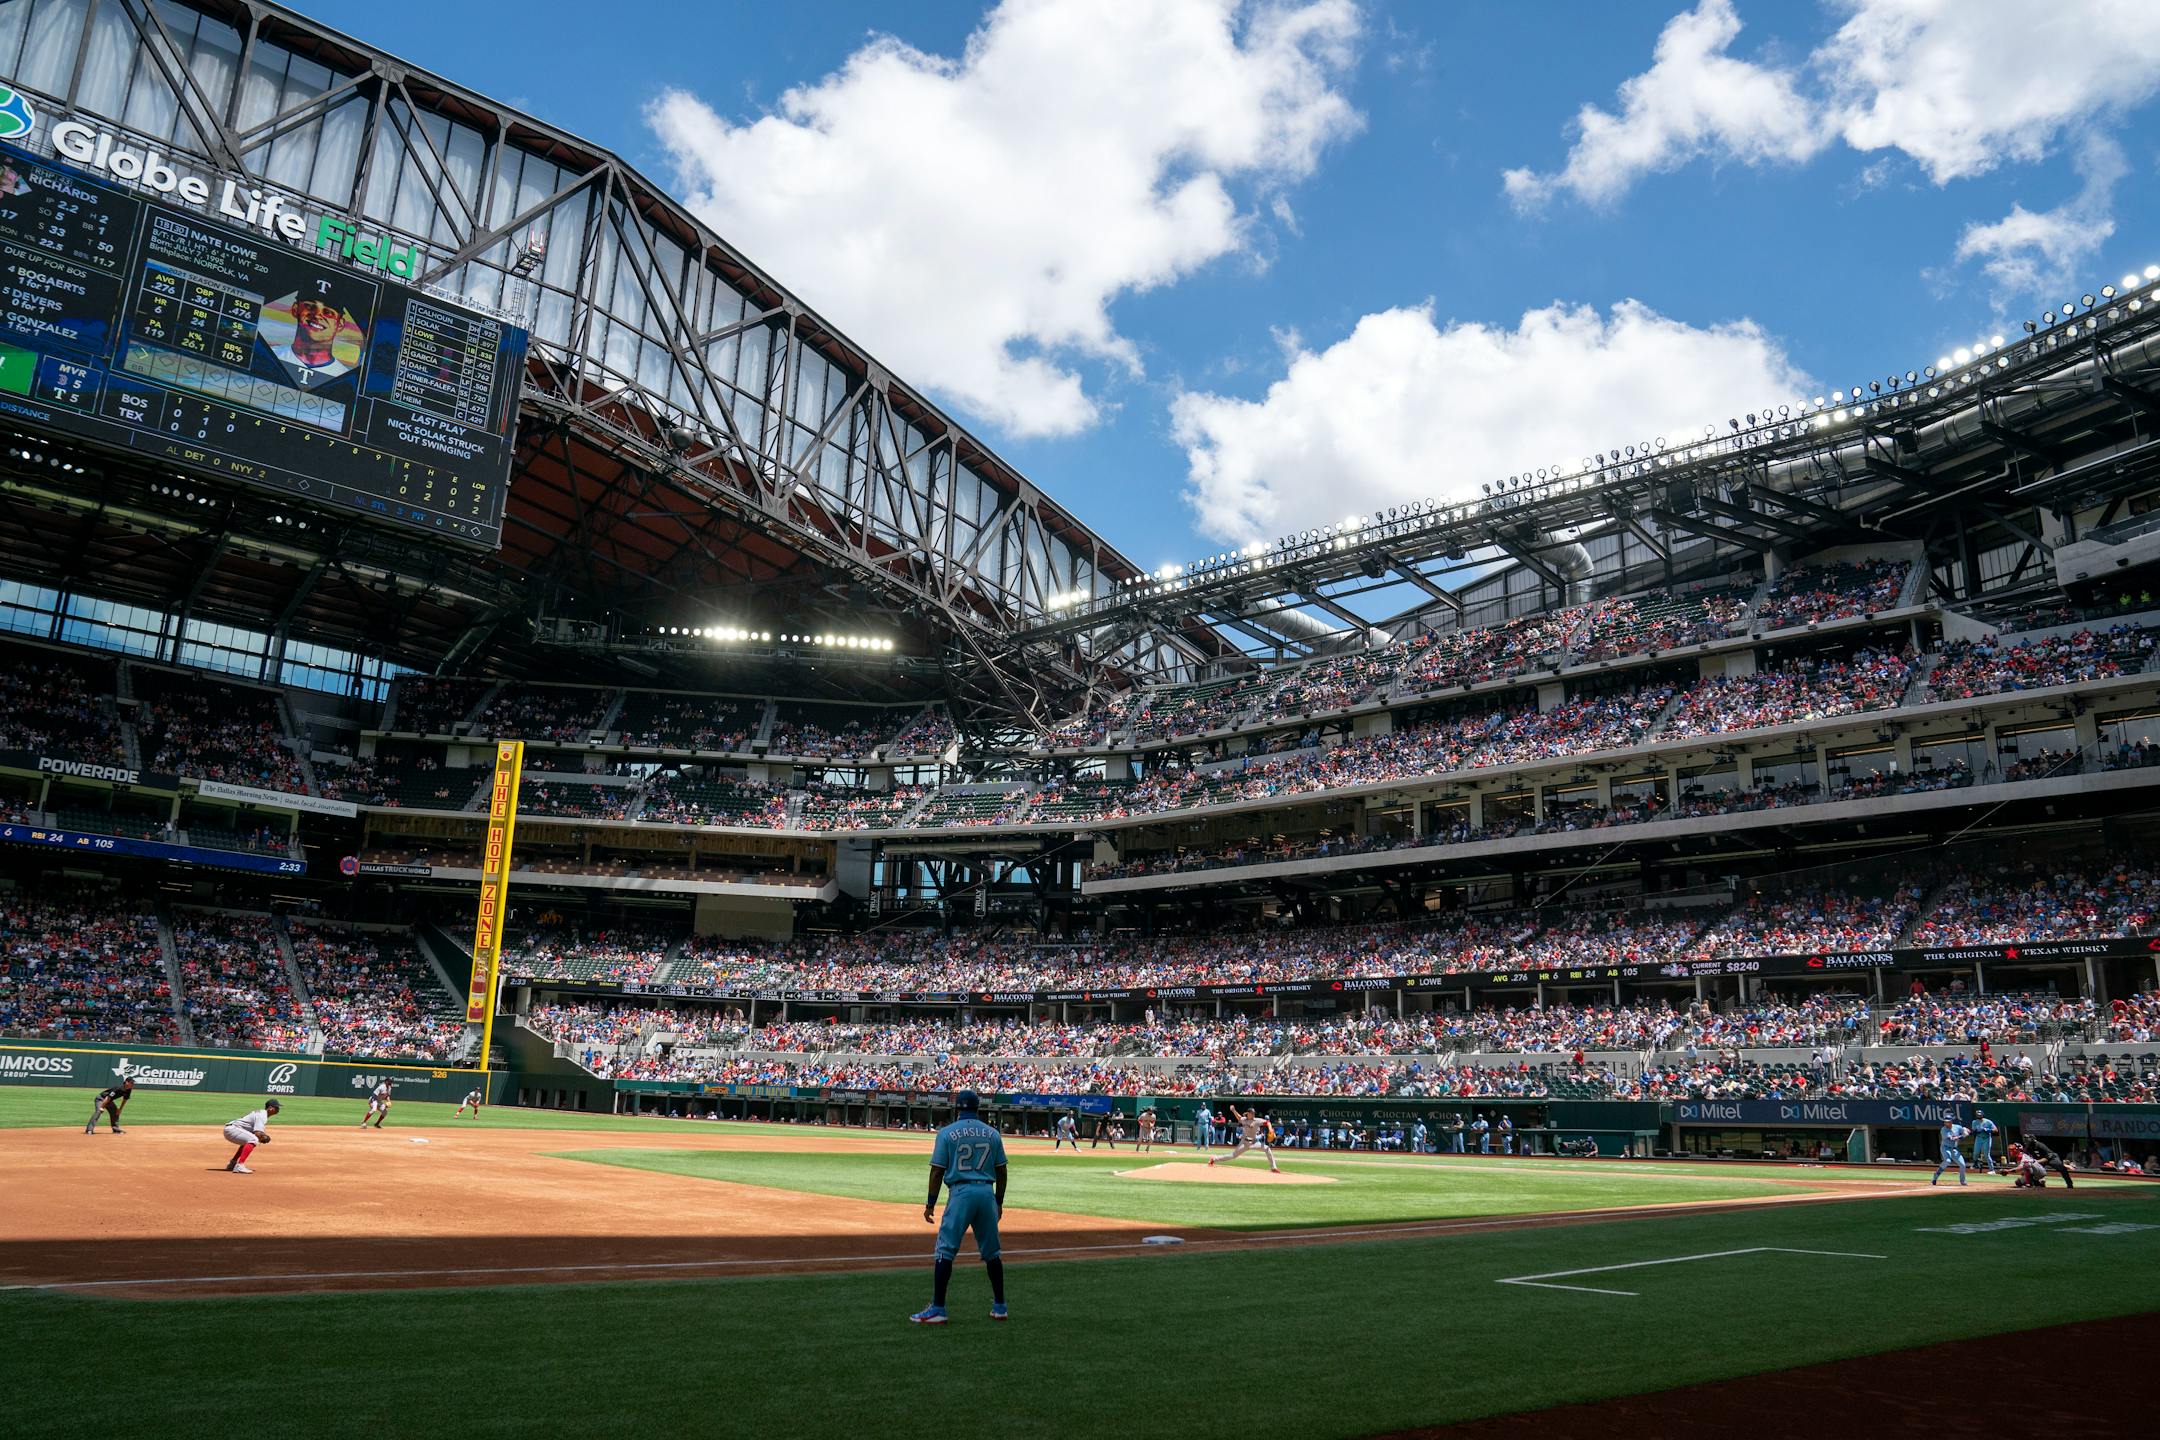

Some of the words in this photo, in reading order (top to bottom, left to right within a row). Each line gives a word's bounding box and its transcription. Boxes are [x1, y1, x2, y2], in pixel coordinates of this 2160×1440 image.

[29, 173, 98, 204] RICHARDS
[52, 121, 209, 204] Globe
[220, 179, 306, 240] Life
[316, 214, 418, 280] Field
[58, 201, 78, 213] 2.2
[55, 212, 64, 221] 5
[99, 215, 108, 224] 2
[49, 226, 65, 237] 33
[39, 238, 64, 251] 22.5
[98, 242, 113, 253] 50
[151, 235, 173, 249] Born:
[174, 244, 194, 256] JULY
[206, 255, 224, 265] 1995
[191, 230, 222, 248] NATE
[224, 242, 257, 260] LOWE
[4, 247, 25, 259] DUE
[28, 254, 42, 262] UP
[44, 259, 65, 271] FOR
[66, 267, 87, 278] BOS
[93, 255, 115, 268] 11.7
[149, 242, 192, 262] Birthplace:
[238, 271, 249, 281] VA
[237, 258, 251, 268] WT
[254, 264, 269, 273] 220
[18, 267, 86, 295] BOGAERTS
[27, 278, 42, 289] for
[155, 274, 175, 285] AVG
[151, 282, 175, 294] .276
[195, 287, 214, 296] OBP
[317, 280, 332, 294] T
[12, 288, 63, 311] DEVERS
[21, 300, 36, 311] for
[154, 297, 168, 306] HR
[191, 295, 214, 307] .361
[234, 300, 250, 309] SLG
[154, 306, 162, 314] 6
[193, 309, 208, 319] RBI
[229, 307, 251, 319] .476
[6, 311, 78, 339] GONZALEZ
[150, 319, 162, 328] PA
[190, 317, 205, 327] 24
[232, 322, 243, 330] SB
[416, 319, 440, 331] SOLAK
[15, 323, 31, 334] for
[144, 326, 165, 338] 119
[232, 330, 239, 338] 2
[414, 329, 434, 340] LOWE
[188, 332, 202, 341] K%
[181, 339, 205, 352] 26.1
[224, 343, 242, 353] BB%
[412, 340, 437, 352] GALLO
[221, 350, 243, 362] 10.9
[60, 364, 87, 378] MVR
[408, 361, 429, 373] DAHL
[298, 367, 313, 384] T
[73, 380, 82, 389] 5
[405, 382, 425, 395] HOLT
[406, 371, 457, 394] KINER-FALEFA
[53, 387, 66, 399] T
[69, 394, 79, 403] 5
[403, 394, 422, 406] HEIM
[0, 401, 51, 421] DISTANCE
[121, 393, 149, 408] BOS
[174, 409, 182, 418] 0
[226, 424, 234, 432] 0
[119, 407, 144, 422] TEX
[171, 423, 179, 431] 0
[198, 430, 206, 438] 0
[411, 413, 438, 427] LAST
[439, 421, 467, 436] PLAY
[387, 418, 412, 432] NICK
[414, 426, 446, 442] SOLAK
[448, 437, 484, 454] STRUCK
[399, 432, 420, 444] OUT
[421, 438, 471, 460] SWINGING
[185, 450, 205, 461] DET
[231, 462, 253, 474] NYY
[400, 486, 407, 494] 0
[424, 493, 431, 501] 2
[449, 500, 455, 508] 0
[38, 757, 139, 784] POWERADE
[217, 786, 235, 795] Dallas
[237, 789, 262, 799] Morning
[262, 793, 278, 801] News
[496, 773, 507, 816] THE
[4, 828, 12, 836] 6
[32, 832, 46, 840] RBI
[49, 833, 63, 843] 24
[95, 840, 114, 848] 105
[279, 862, 300, 872] 2:33
[490, 829, 501, 873] HOT
[481, 887, 495, 947] ZONE
[1948, 950, 2002, 960] ORIGINAL
[2022, 947, 2059, 956] TEXAS
[2062, 944, 2108, 953] WHISKY
[1826, 954, 1894, 964] BALCONES
[1692, 968, 1722, 976] JACKPOT
[1726, 962, 1760, 972] $8240
[1511, 973, 1528, 982] .276
[1553, 972, 1558, 980] 6
[1585, 970, 1596, 978] 24
[1623, 968, 1638, 976] 105
[1344, 979, 1390, 987] BALCONES
[1420, 978, 1442, 986] LOWE
[1157, 988, 1195, 996] BALCONES
[0, 1056, 74, 1072] IMROSS
[139, 1065, 204, 1080] Germania
[268, 1064, 297, 1084] B
[432, 1071, 447, 1079] 326
[267, 1085, 295, 1093] SPORTS
[1273, 1109, 1310, 1117] CHOCTAW
[1323, 1110, 1363, 1118] CHOCTAW
[1377, 1111, 1418, 1119] CHOCTAW
[1702, 1104, 1742, 1119] Mitel
[1804, 1104, 1847, 1120] Mitel
[949, 1128, 994, 1142] BEASLEY
[957, 1143, 990, 1171] 27
